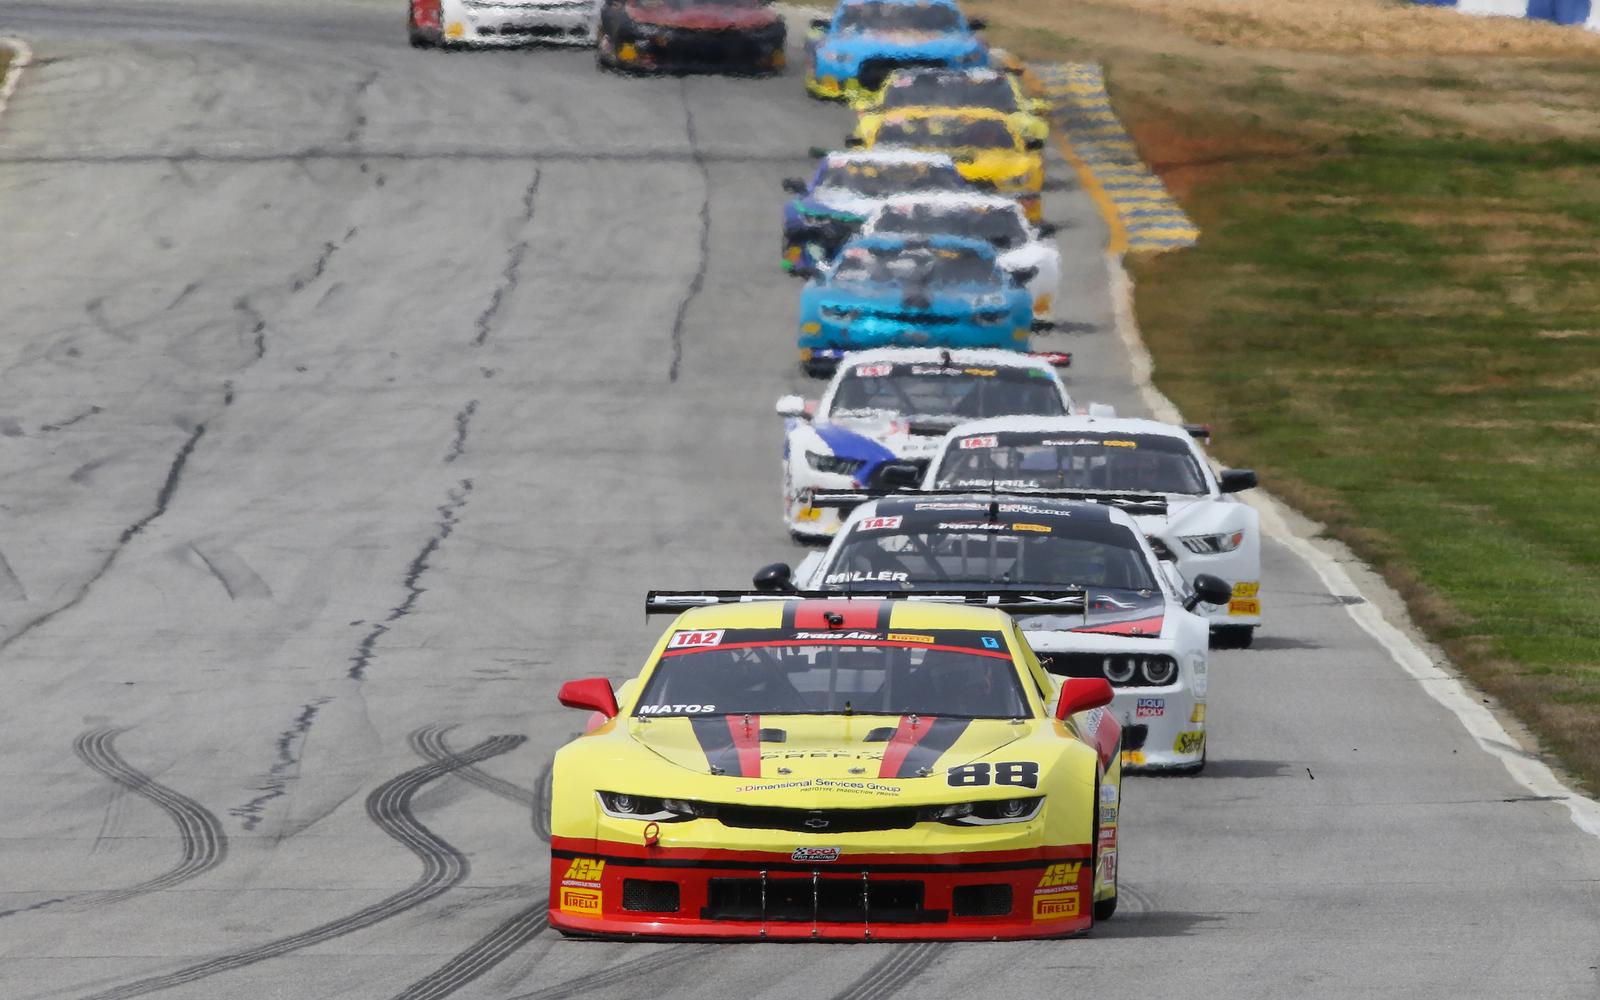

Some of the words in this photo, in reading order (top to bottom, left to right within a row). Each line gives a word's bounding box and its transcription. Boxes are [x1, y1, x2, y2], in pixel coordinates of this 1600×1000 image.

[825, 570, 909, 584] MILLER
[676, 631, 719, 646] TA2
[795, 632, 844, 640] Trans
[843, 631, 879, 640] Am
[639, 704, 716, 714] MATOS
[1138, 699, 1165, 707] LIQUI
[1137, 707, 1164, 716] MOLY
[760, 752, 884, 761] PREFIX
[946, 761, 1039, 790] 88
[744, 779, 812, 793] Dimensional
[815, 778, 864, 790] Services
[866, 782, 901, 793] Group
[807, 847, 837, 855] SCCA
[563, 857, 606, 882] AEM
[1038, 862, 1082, 887] AEM
[563, 891, 599, 909] PIRELLI
[1037, 896, 1076, 915] PIRELLI
